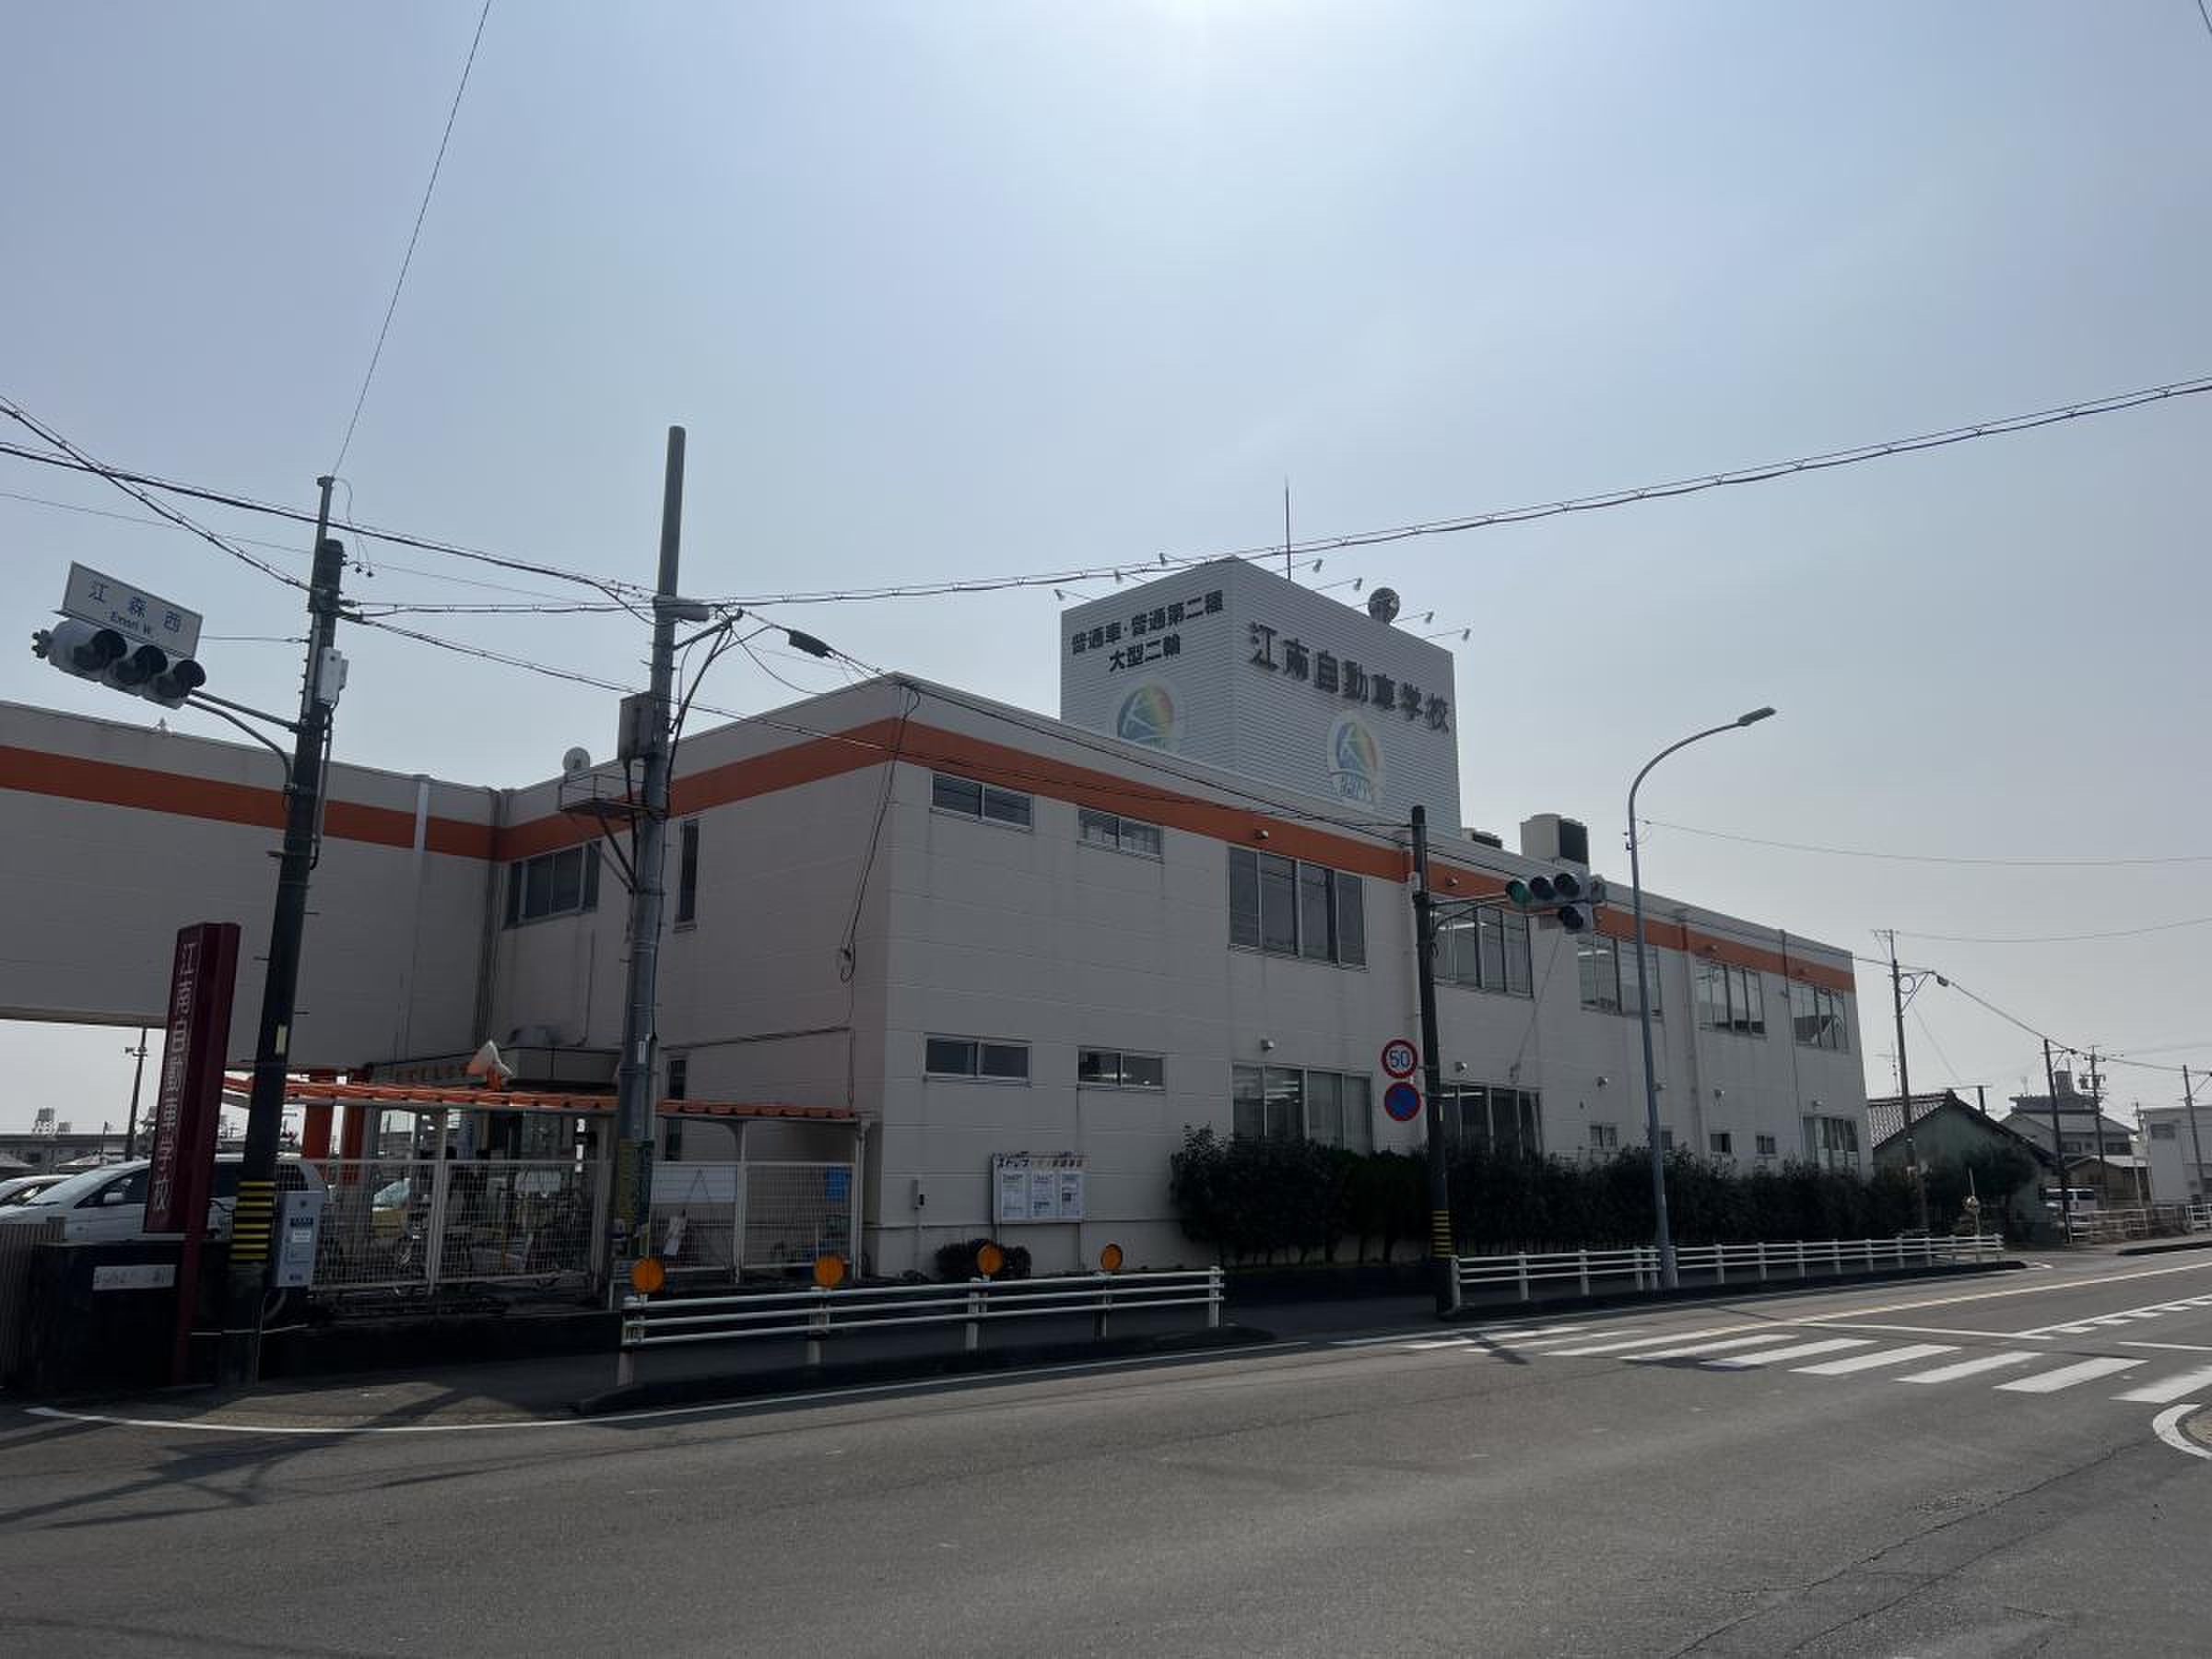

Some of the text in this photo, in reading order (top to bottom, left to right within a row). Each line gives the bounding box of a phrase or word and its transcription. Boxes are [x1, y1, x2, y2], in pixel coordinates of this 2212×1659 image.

[88, 580, 182, 633] 江森西
[1109, 633, 1181, 673] 大型二輪
[1250, 621, 1450, 734] 江南自動車学校
[1389, 1049, 1411, 1068] 50
